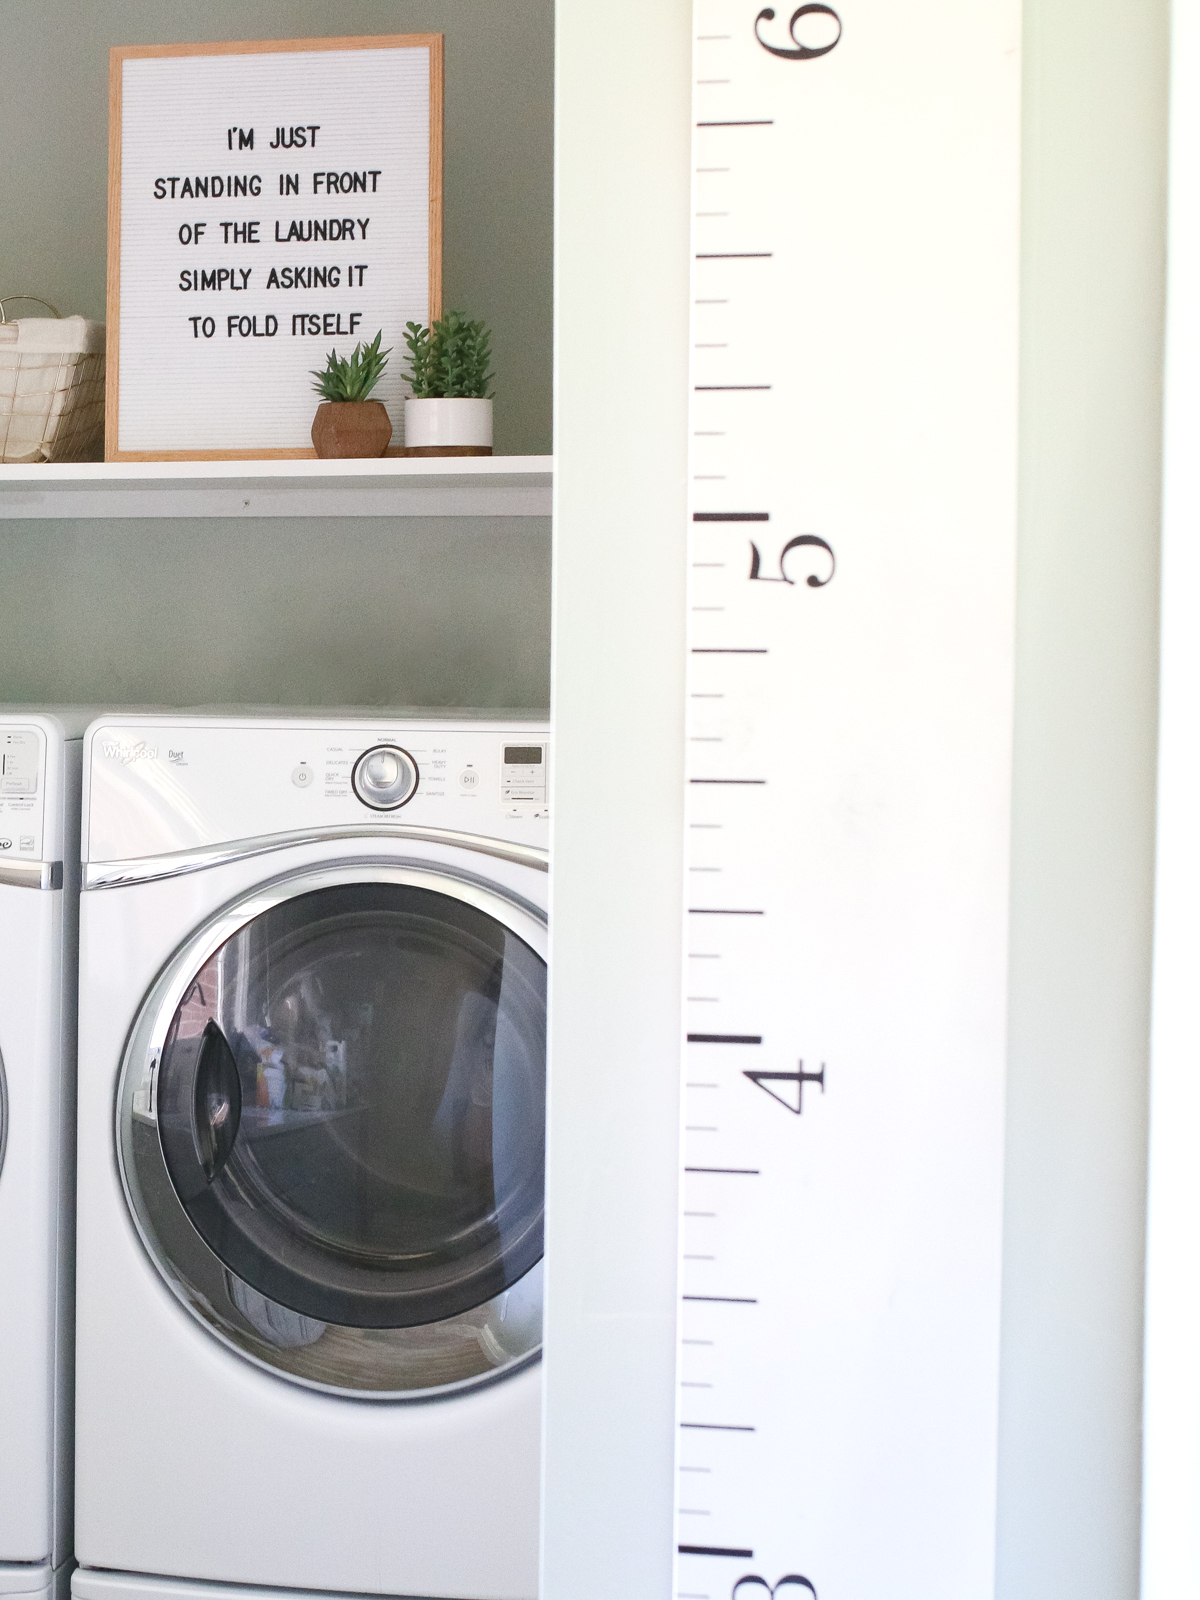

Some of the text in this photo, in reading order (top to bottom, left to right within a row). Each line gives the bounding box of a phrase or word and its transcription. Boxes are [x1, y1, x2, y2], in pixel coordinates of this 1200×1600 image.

[755, 3, 842, 60] 6
[227, 125, 321, 151] I'M JUST
[153, 170, 382, 200] STANDING IN FRONT
[178, 217, 370, 246] OF THE LAUNDRY
[178, 264, 369, 292] SIMPLY ASKING IT
[188, 312, 363, 339] TO FOLD ITSELF
[750, 535, 835, 588] 5
[103, 745, 158, 762] Whirlpool
[168, 749, 184, 758] Duet
[742, 1061, 824, 1115] 4
